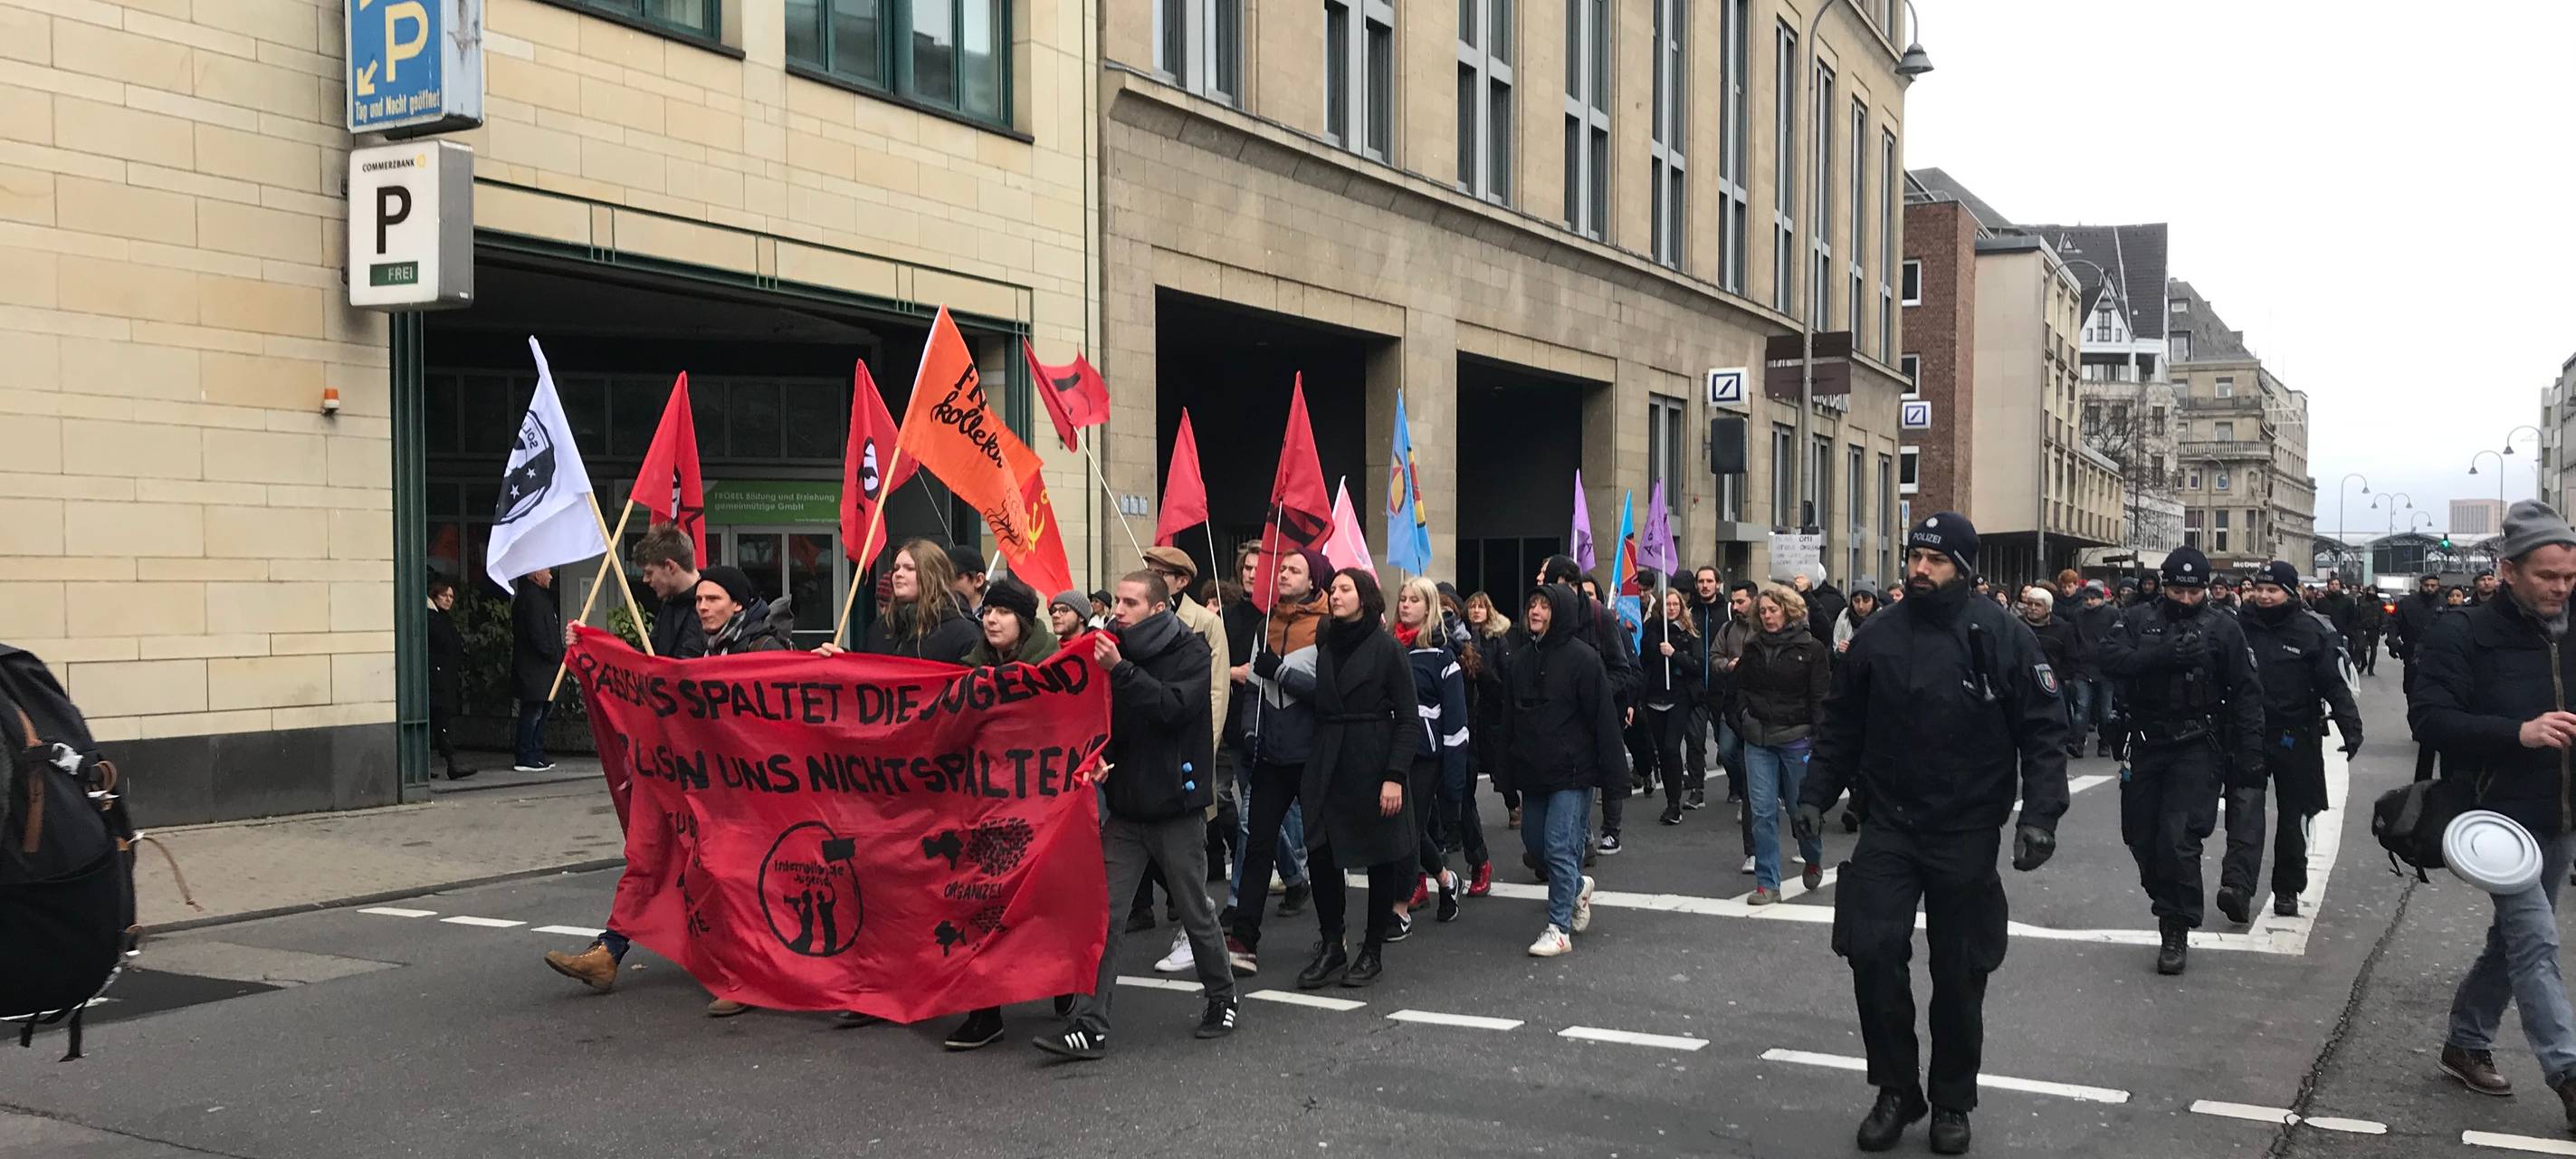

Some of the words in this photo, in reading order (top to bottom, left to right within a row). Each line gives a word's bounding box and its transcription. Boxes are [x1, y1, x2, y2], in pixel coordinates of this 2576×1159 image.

[385, 3, 429, 82] P
[355, 101, 367, 123] Tag
[369, 95, 383, 119] und
[386, 93, 407, 116] Nacht
[409, 89, 440, 116] geöffnet
[362, 159, 415, 173] COMMERZBANK
[377, 186, 412, 254] P
[387, 266, 413, 282] FREI
[778, 503, 804, 511] GmbH
[1913, 532, 1942, 544] POLIZEI
[678, 680, 844, 723] SPALTET
[854, 683, 922, 725] DIE
[919, 655, 1088, 722] JUGEND
[716, 753, 800, 793] UNS
[806, 752, 911, 795] NICHT
